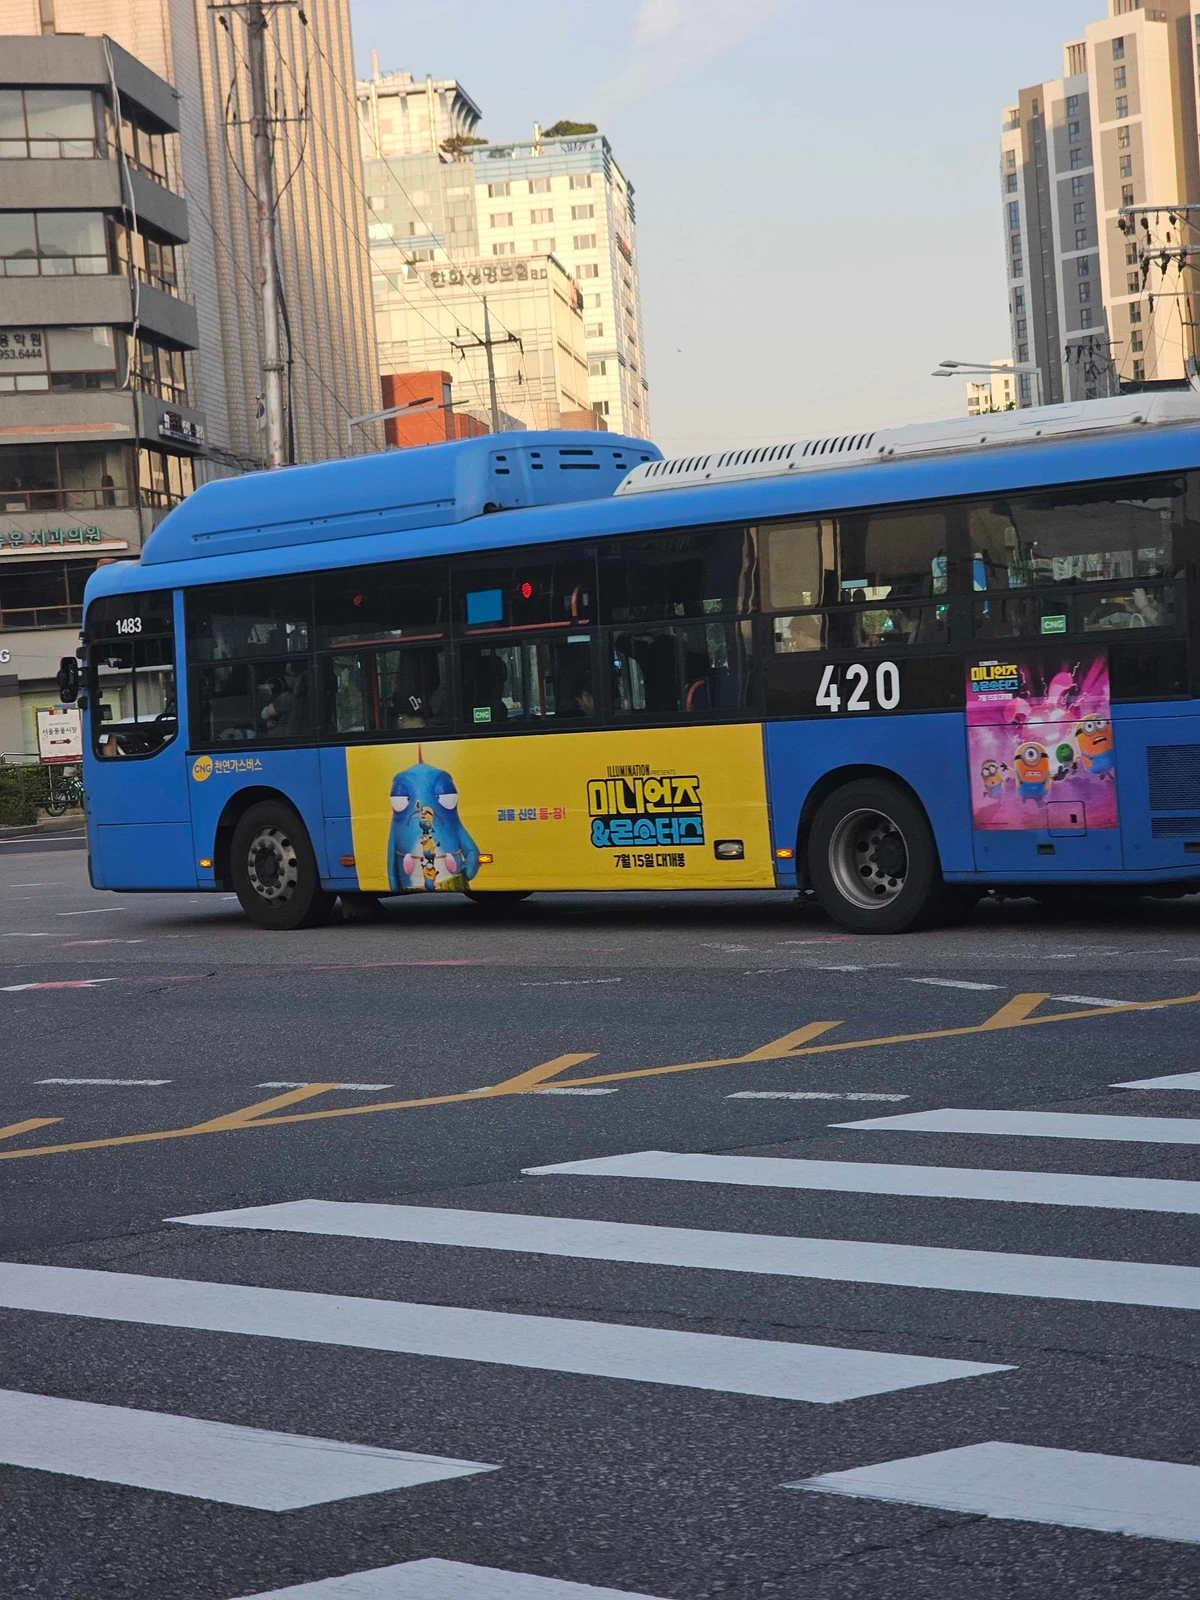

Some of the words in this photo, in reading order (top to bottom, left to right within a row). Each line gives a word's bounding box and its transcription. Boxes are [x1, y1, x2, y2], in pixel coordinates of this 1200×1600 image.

[31, 526, 101, 547] 치과의원
[116, 617, 142, 634] 1483
[1044, 620, 1063, 628] CNG
[971, 665, 1018, 680] 미니언즈
[816, 661, 900, 712] 420
[194, 764, 212, 773] CNG
[214, 758, 263, 774] 천연가스버스
[606, 764, 651, 777] ILLUMINATION
[587, 776, 702, 816] 미니언즈
[518, 808, 537, 820] 신인
[591, 817, 704, 848] &몬스터즈
[613, 854, 631, 868] 7월
[632, 853, 654, 867] 15일
[656, 853, 685, 867] 대개봉
